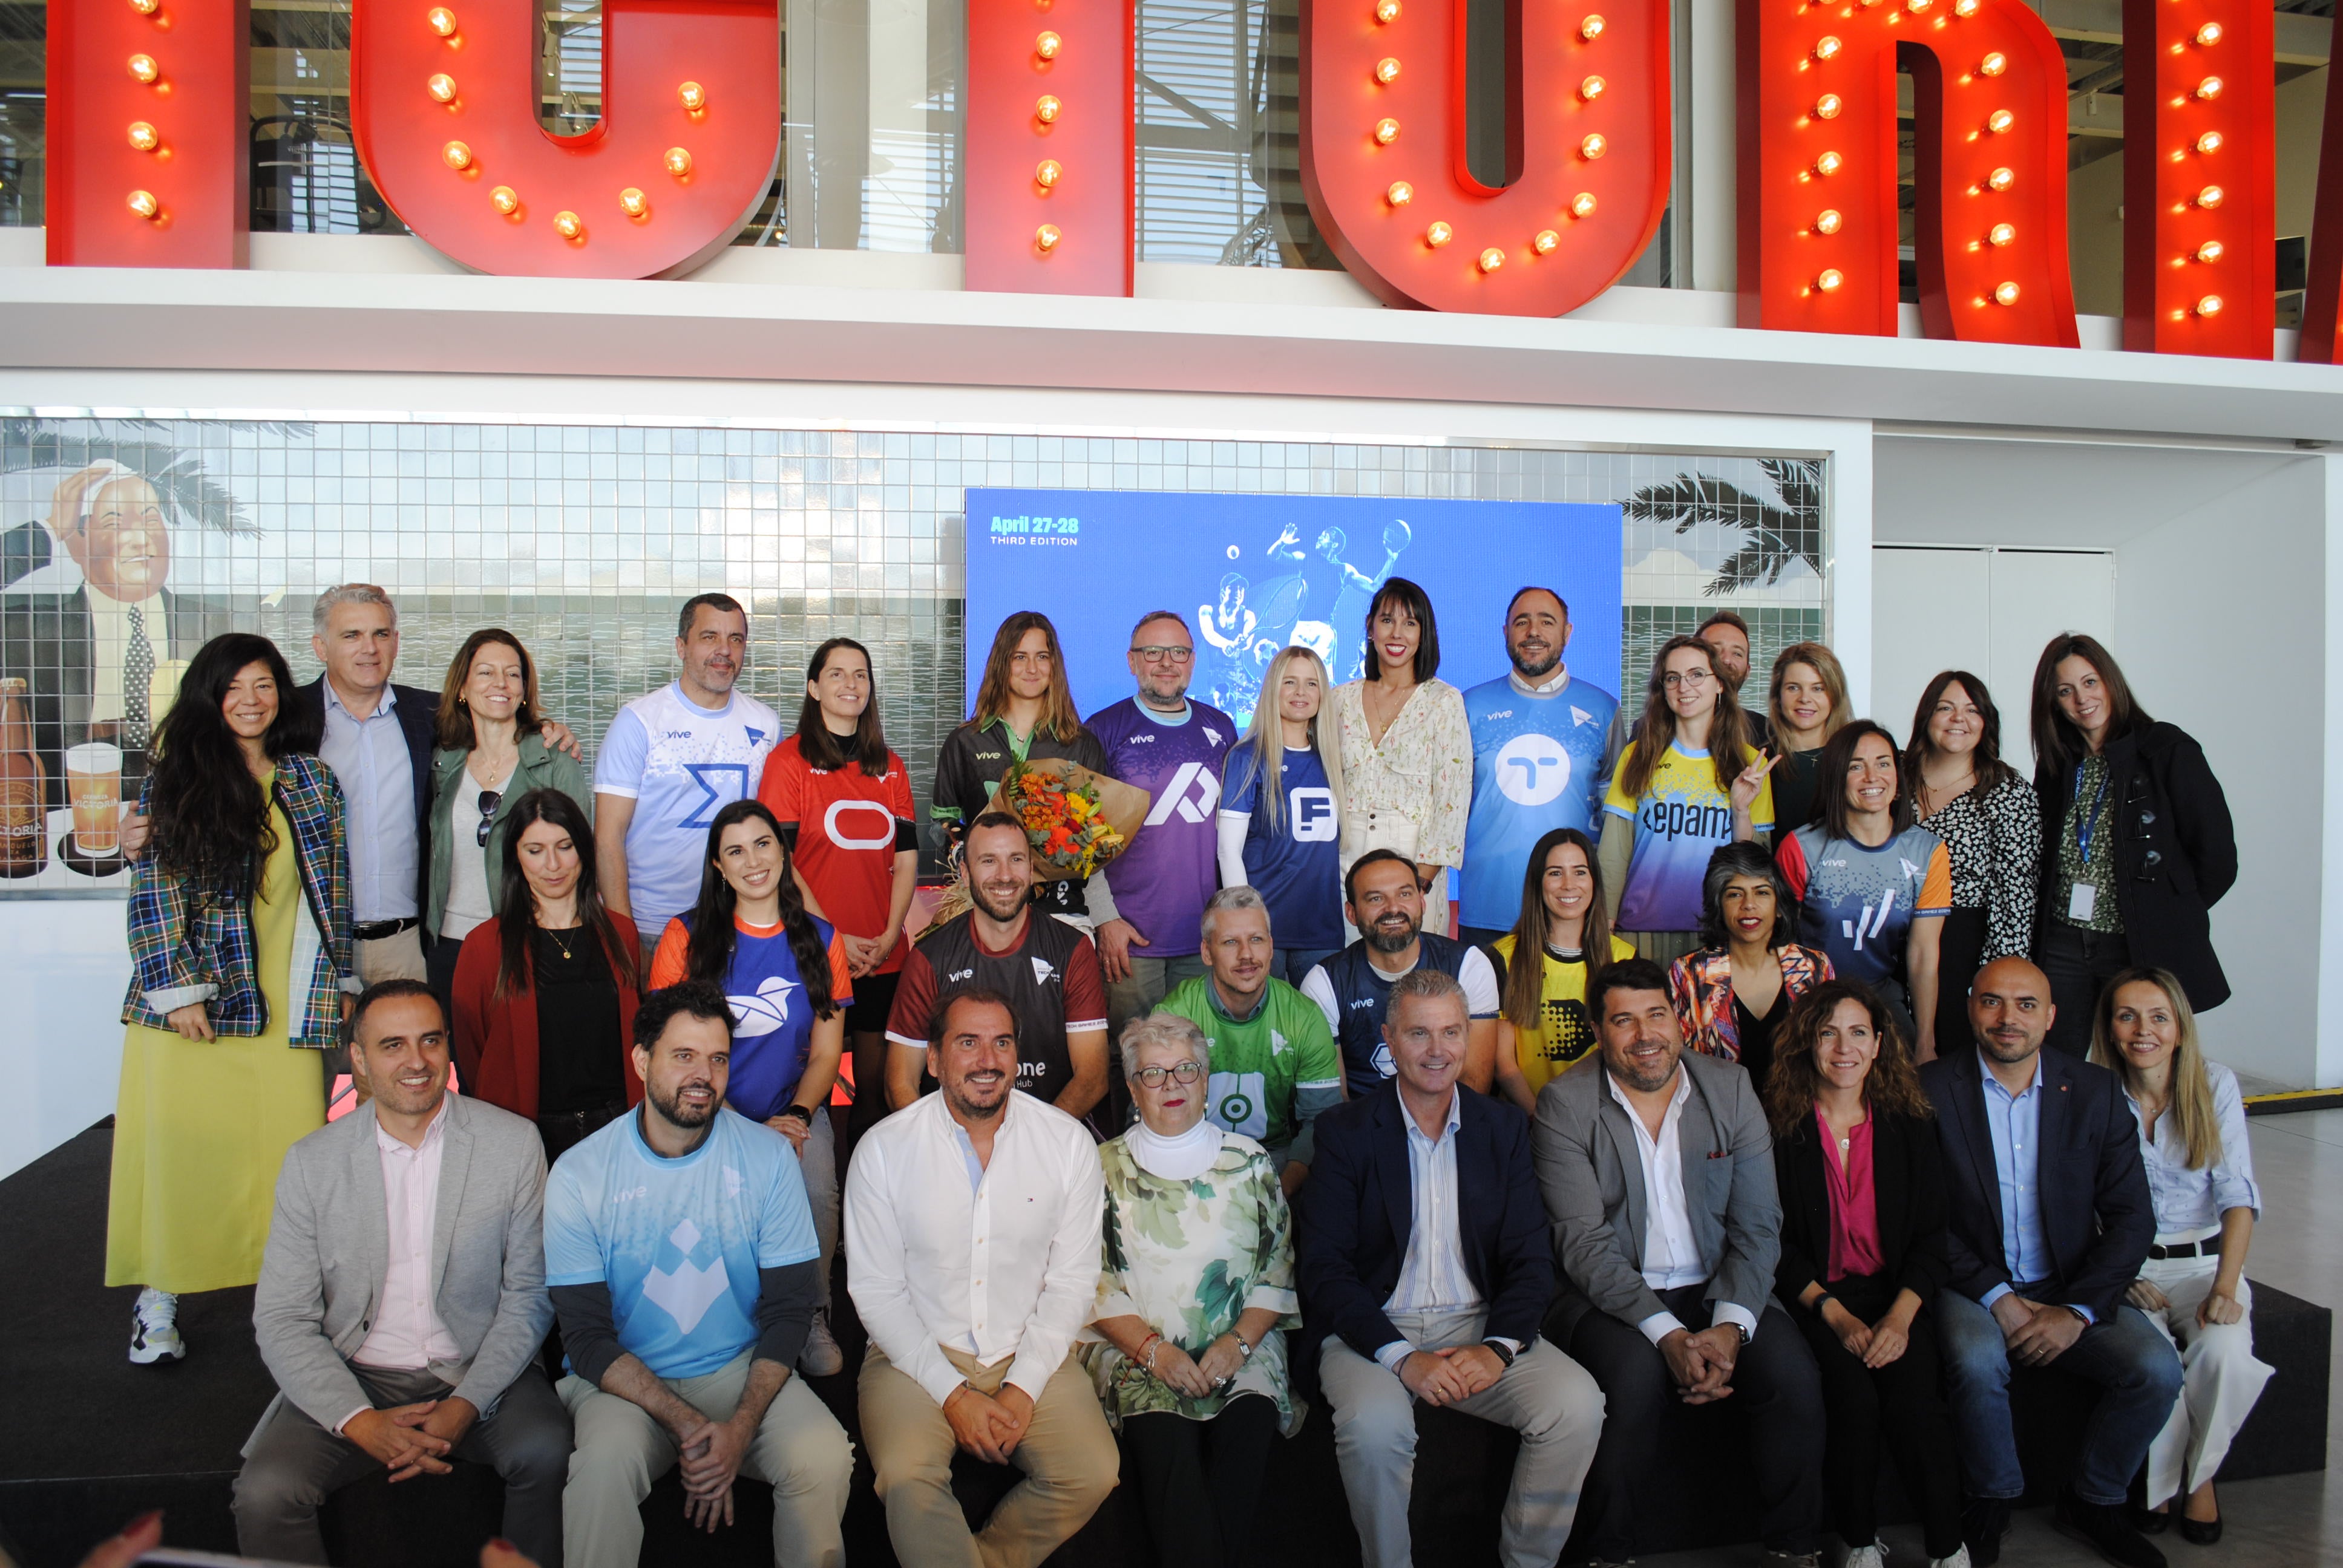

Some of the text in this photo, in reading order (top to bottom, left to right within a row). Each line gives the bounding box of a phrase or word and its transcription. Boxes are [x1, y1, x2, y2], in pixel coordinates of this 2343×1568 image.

[991, 515, 1079, 535] April 27-28
[991, 536, 1077, 546] THIRD EDITION
[1487, 710, 1512, 720] vive
[667, 730, 691, 739] vive
[1130, 734, 1155, 744] vive
[975, 751, 1001, 760] vive
[73, 797, 119, 809] VICTORIA
[1822, 858, 1846, 866] vive
[949, 969, 973, 982] vive
[1351, 998, 1374, 1010] vive
[1017, 1079, 1033, 1088] Hub
[613, 1186, 647, 1204] vive
